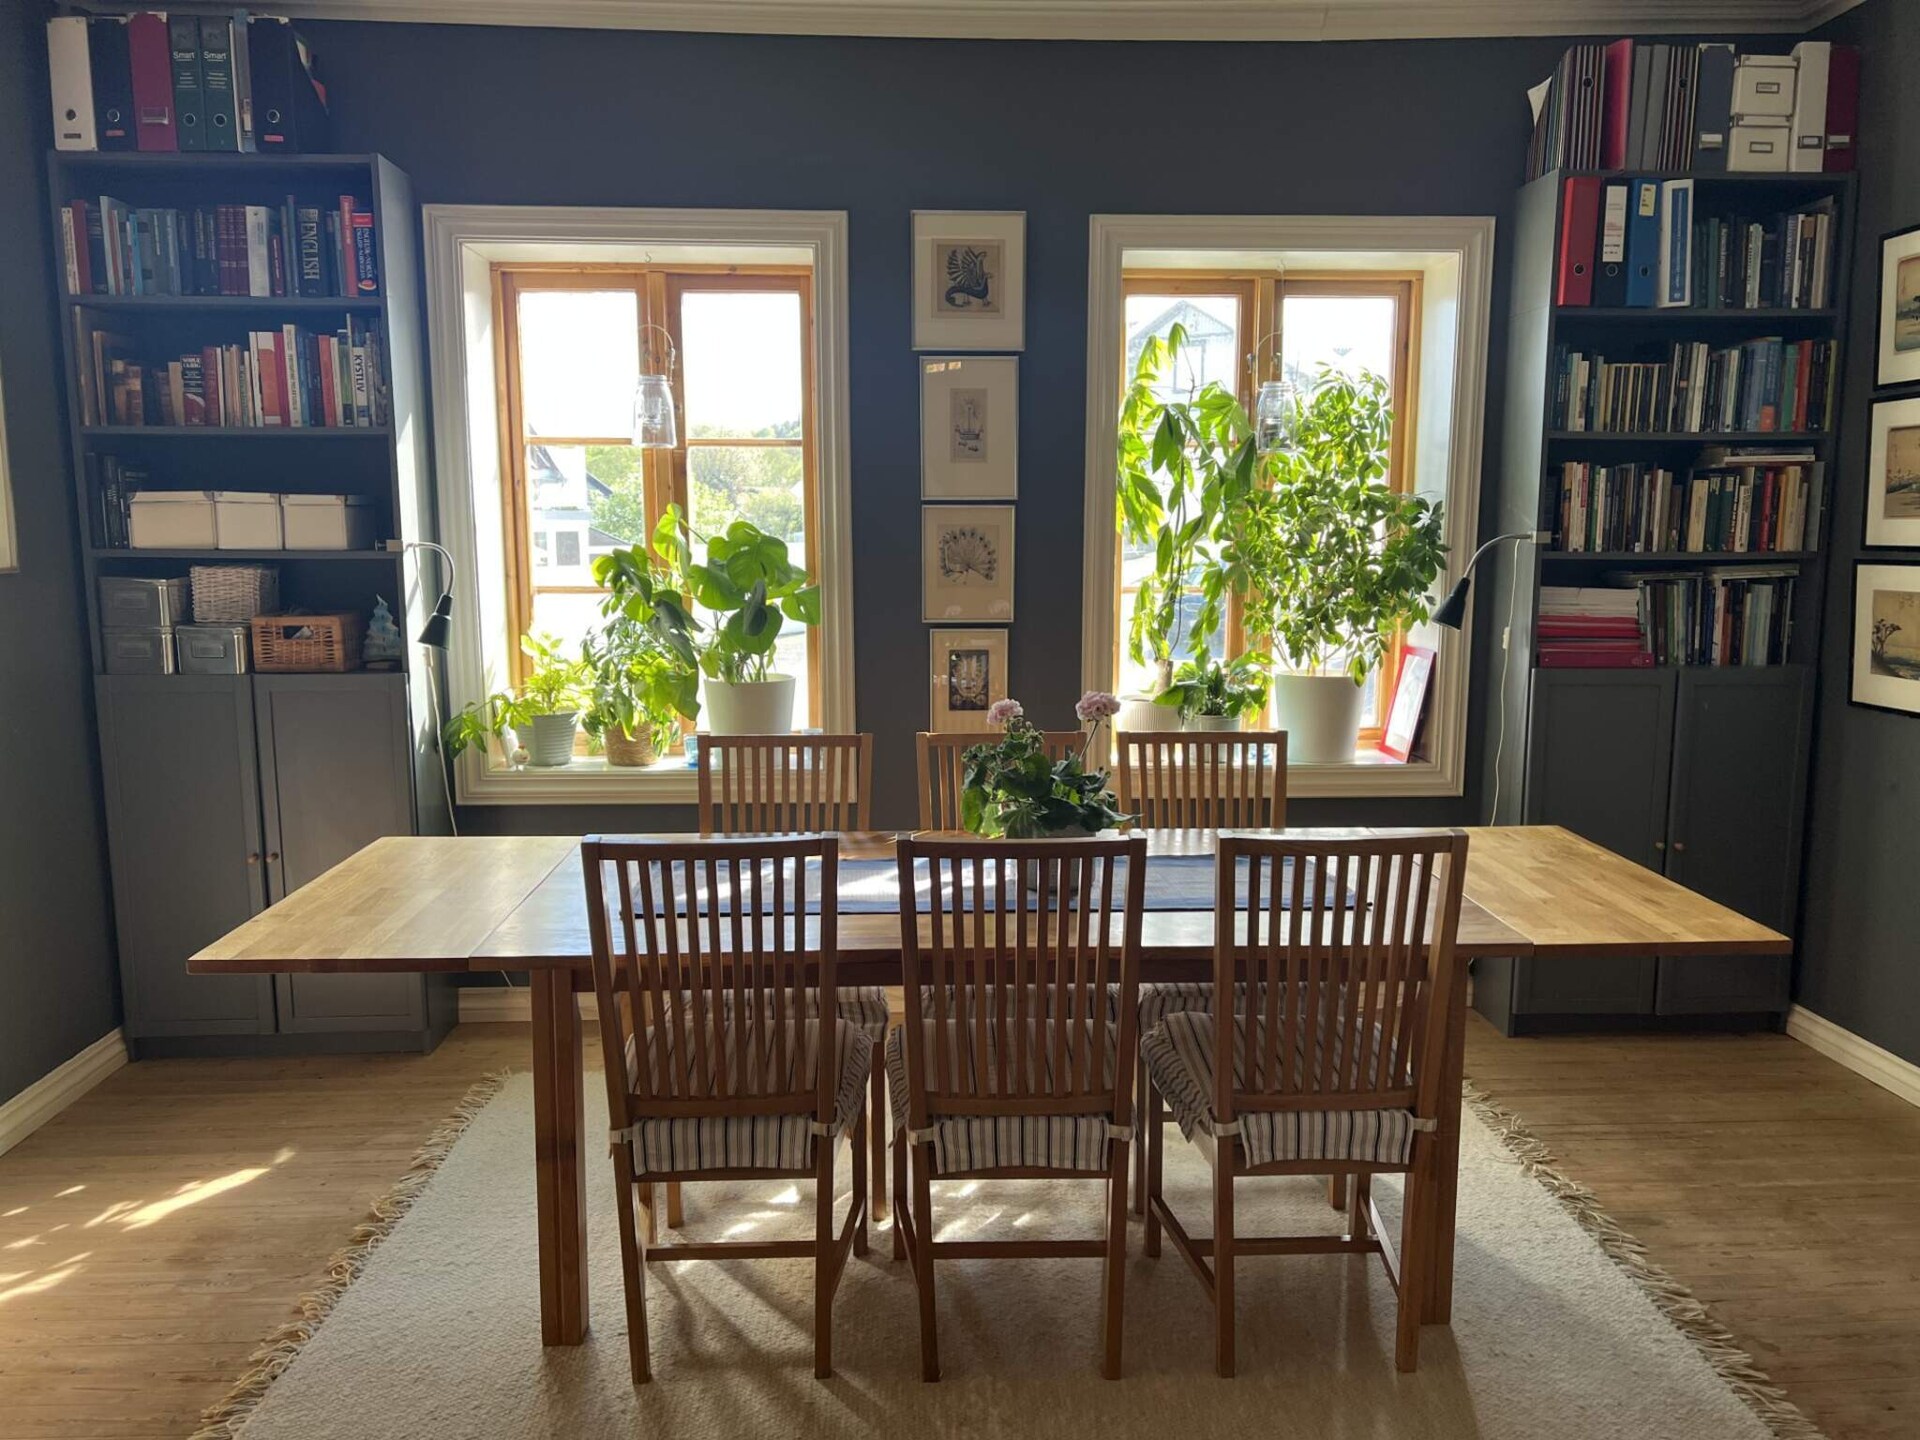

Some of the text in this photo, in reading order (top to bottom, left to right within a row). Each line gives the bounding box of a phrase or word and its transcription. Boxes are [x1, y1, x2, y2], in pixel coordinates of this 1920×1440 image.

[173, 51, 195, 59] Smart
[203, 51, 226, 59] Smart
[301, 223, 320, 280] ENGLISH
[353, 354, 365, 392] KYSTLIV
